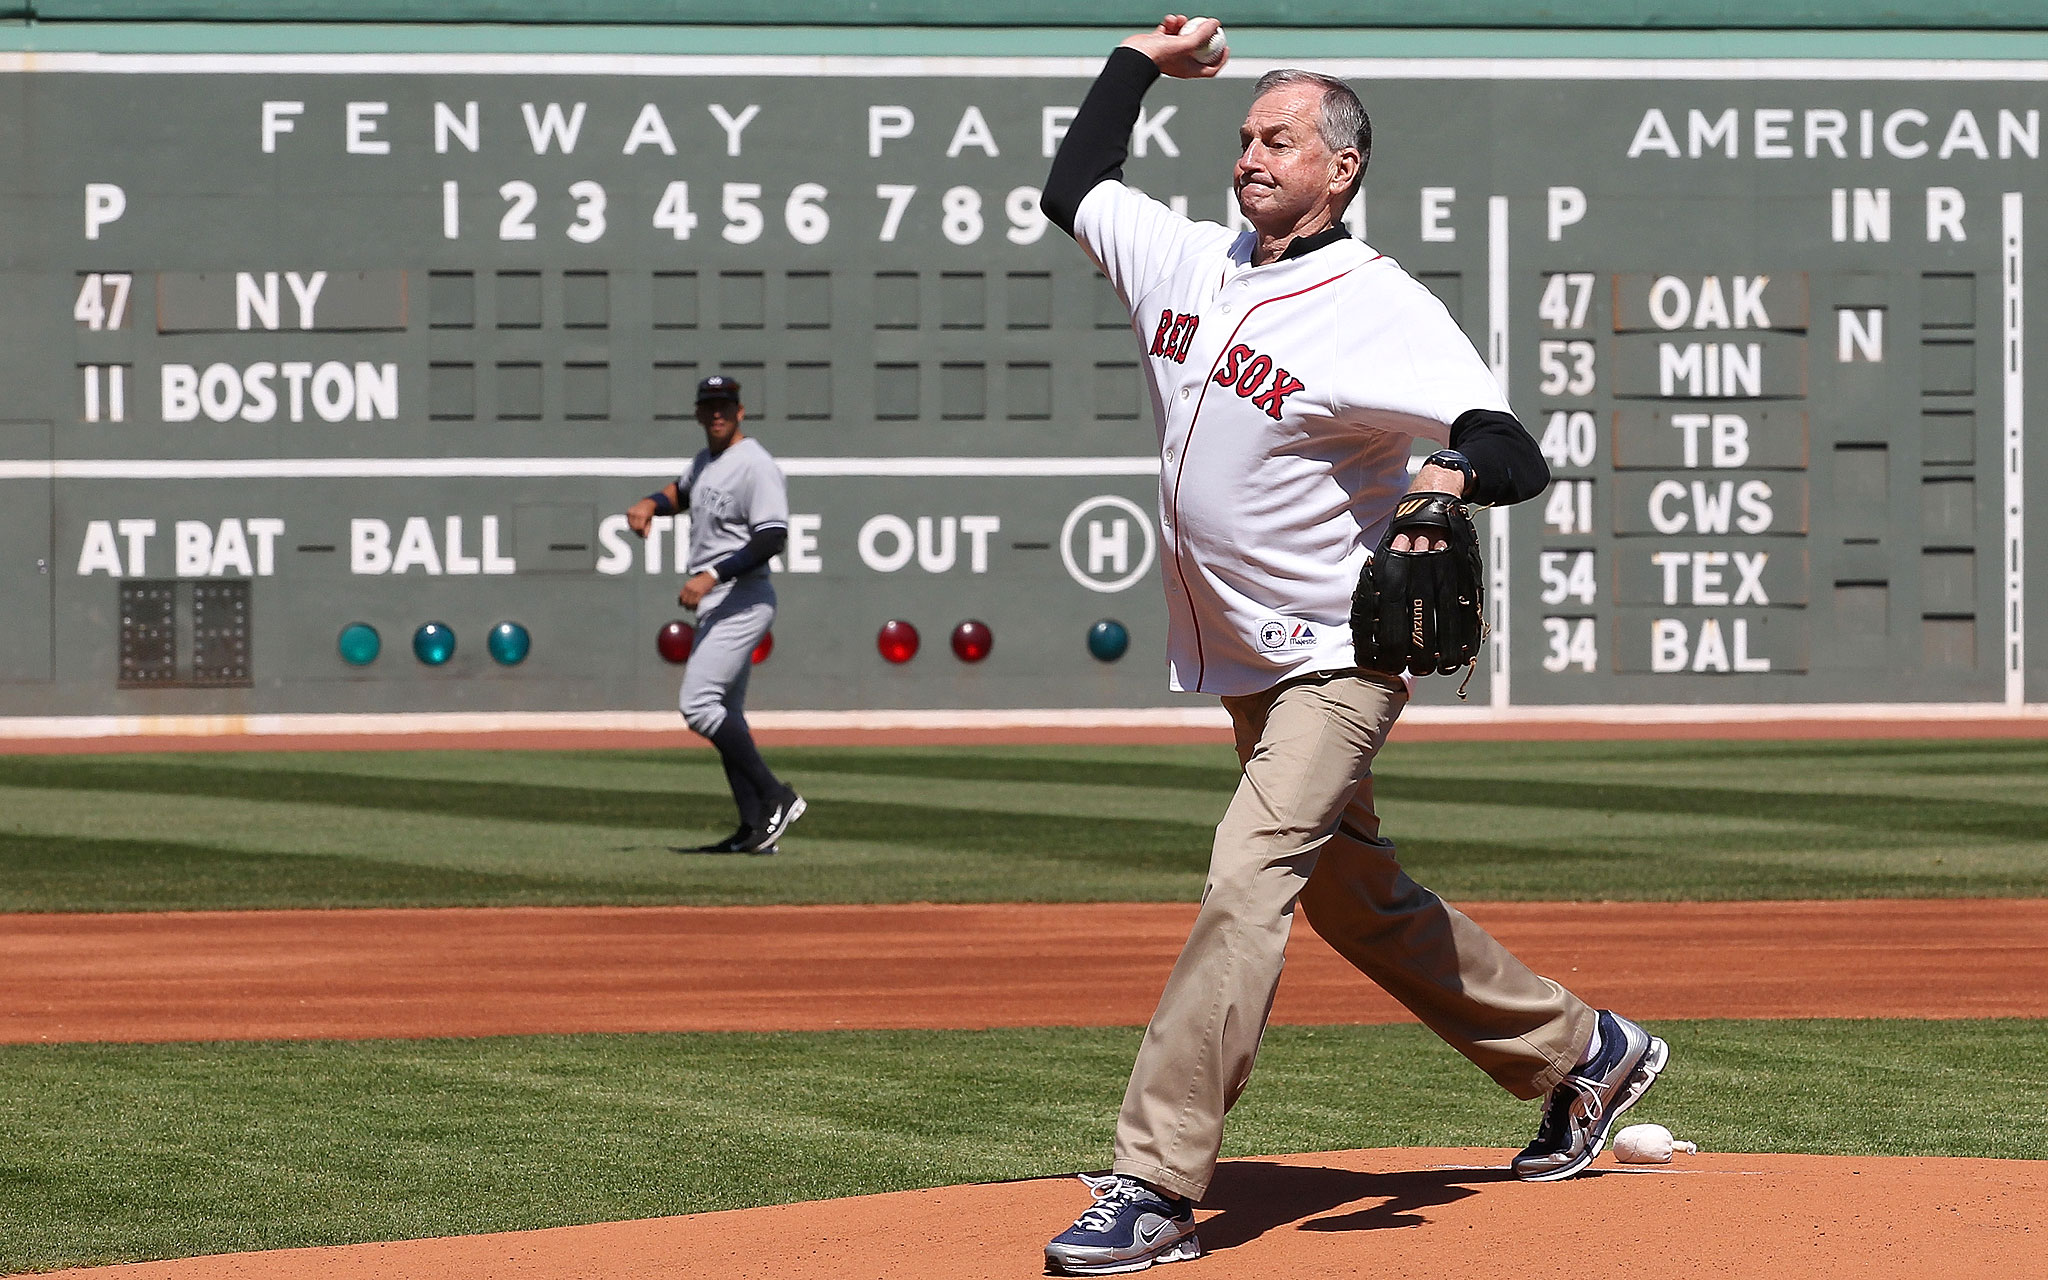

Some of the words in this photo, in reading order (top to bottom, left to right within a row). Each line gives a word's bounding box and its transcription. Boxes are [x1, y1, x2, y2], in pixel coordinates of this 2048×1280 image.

[261, 101, 760, 157] FENWAY
[1627, 108, 2040, 160] AMERICAN
[85, 183, 127, 240] P
[443, 180, 459, 239] 1
[498, 180, 538, 241] 2
[565, 180, 607, 243] 3
[652, 180, 698, 241] 4
[721, 182, 764, 245] 5
[784, 182, 830, 245] 6
[876, 184, 917, 242] 7
[941, 185, 984, 245] 8
[1005, 185, 1049, 245] 9
[1420, 186, 1456, 243] E
[1547, 187, 1587, 242] P
[1831, 188, 1891, 242] IN
[1926, 187, 1967, 242] R
[74, 273, 132, 330] 47
[235, 271, 327, 330] NY
[1539, 273, 1595, 329] 47
[1648, 275, 1771, 330] OAK
[1149, 308, 1199, 364] RED
[1838, 309, 1883, 363] N
[84, 365, 124, 422] 11
[161, 361, 398, 422] BOSTON
[1212, 343, 1305, 421] SOX
[1539, 341, 1596, 397] 53
[1659, 342, 1762, 397] MIN
[1541, 411, 1597, 467] 40
[1671, 413, 1750, 468] TB
[1544, 480, 1592, 535] 41
[1648, 479, 1774, 535] CWS
[77, 518, 157, 577] AT
[175, 518, 285, 577] BAT
[350, 515, 516, 575] BALL
[596, 513, 822, 575] STE
[857, 514, 1001, 574] OUT
[1087, 518, 1130, 574] H
[1539, 551, 1597, 605] 54
[1651, 551, 1770, 606] TEX
[1542, 617, 1598, 673] 34
[1651, 618, 1771, 673] BAL
